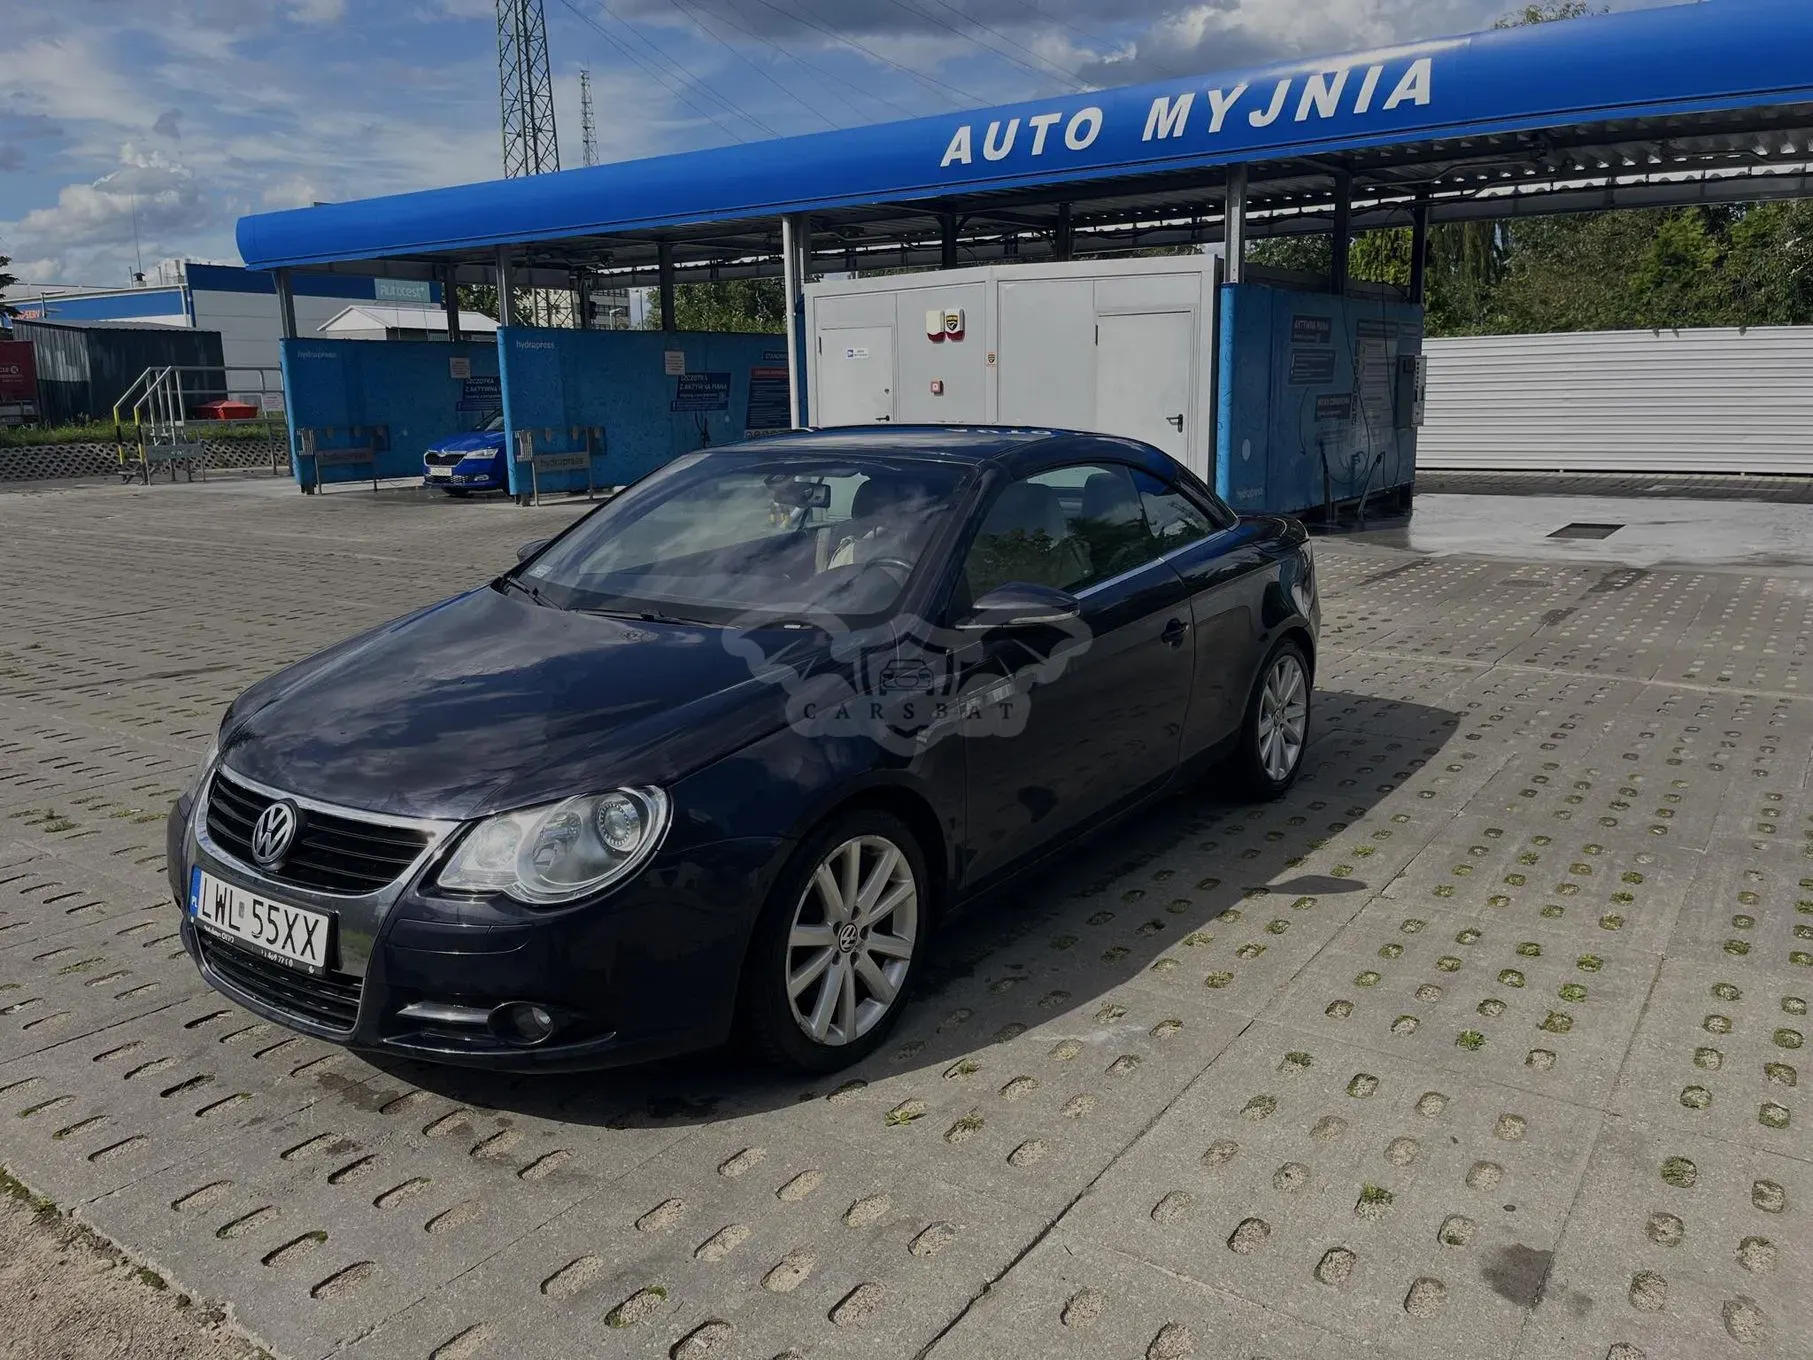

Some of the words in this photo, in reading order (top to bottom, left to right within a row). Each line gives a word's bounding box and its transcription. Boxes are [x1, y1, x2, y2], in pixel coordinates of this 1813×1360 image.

[940, 107, 1103, 167] AUTO
[1141, 58, 1432, 141] MYJNIA
[202, 877, 241, 932] LWL
[251, 898, 320, 961] 55XX
